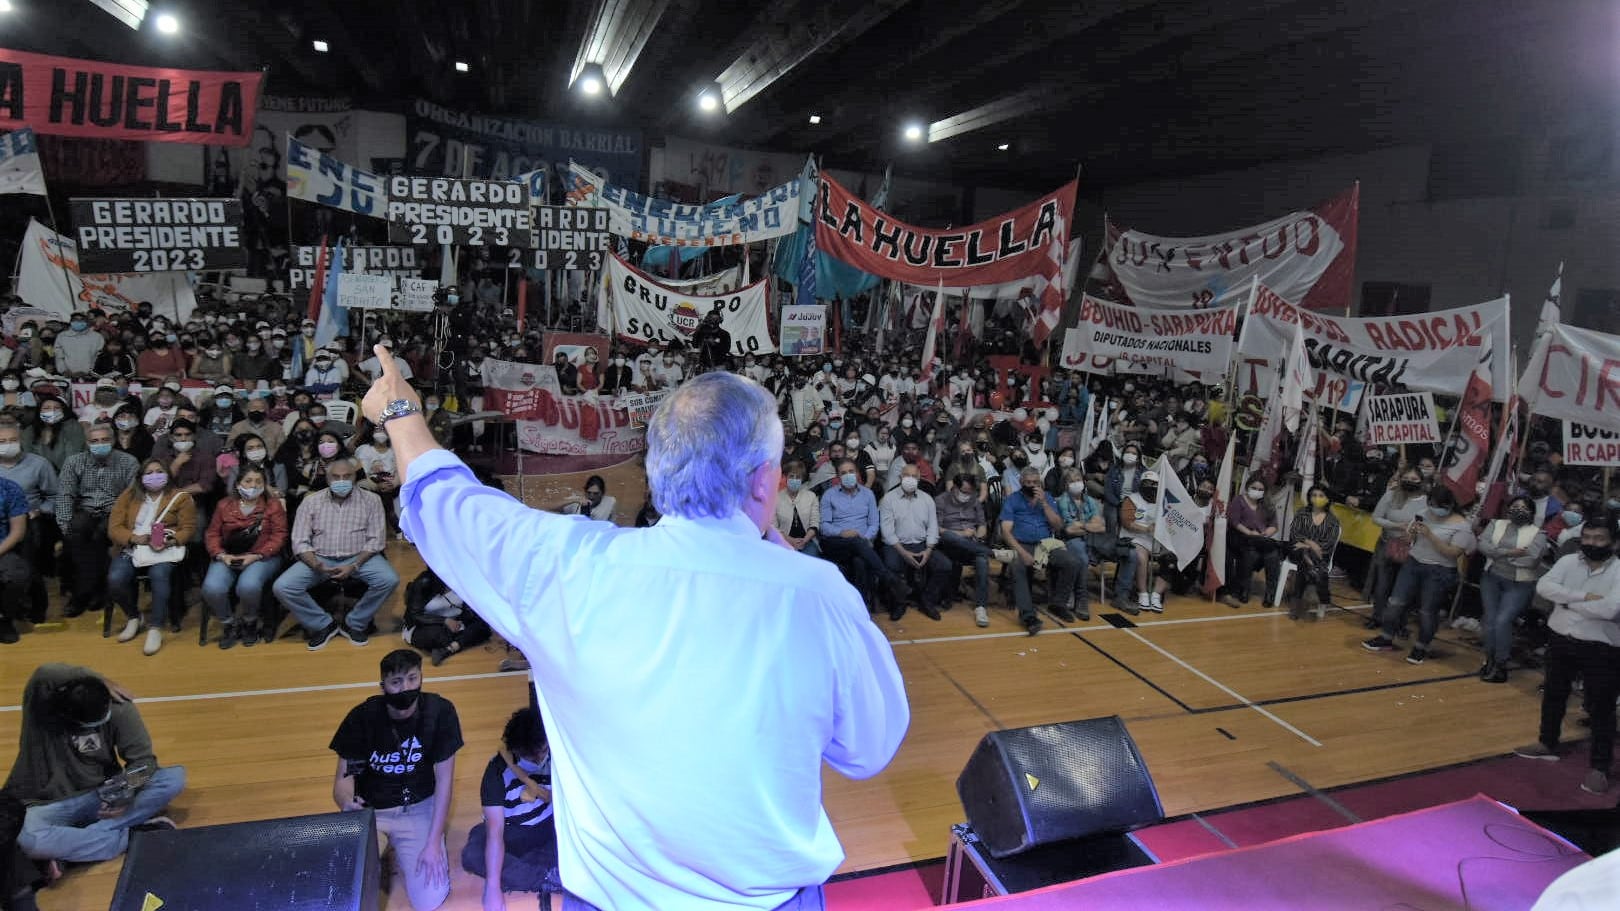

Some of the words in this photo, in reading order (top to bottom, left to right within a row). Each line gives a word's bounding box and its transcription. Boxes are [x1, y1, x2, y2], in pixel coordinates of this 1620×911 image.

[48, 67, 243, 135] HUELLA
[414, 131, 440, 169] 7
[391, 176, 522, 203] GERARDO
[92, 201, 226, 225] GERARDO
[389, 202, 530, 231] PRESIDENTE
[818, 178, 864, 244] LA
[871, 199, 1059, 267] HUELLA
[79, 225, 240, 250] PRESIDENTE
[411, 226, 509, 246] 2023
[132, 249, 205, 272] 2023
[509, 248, 602, 270] 2023
[676, 317, 695, 327] UCR
[1364, 311, 1483, 351] RADICAL
[1093, 331, 1145, 350] DIPUTADOS
[1146, 338, 1213, 355] NACIONALES
[369, 745, 422, 764] hustle
[370, 763, 416, 774] trees
